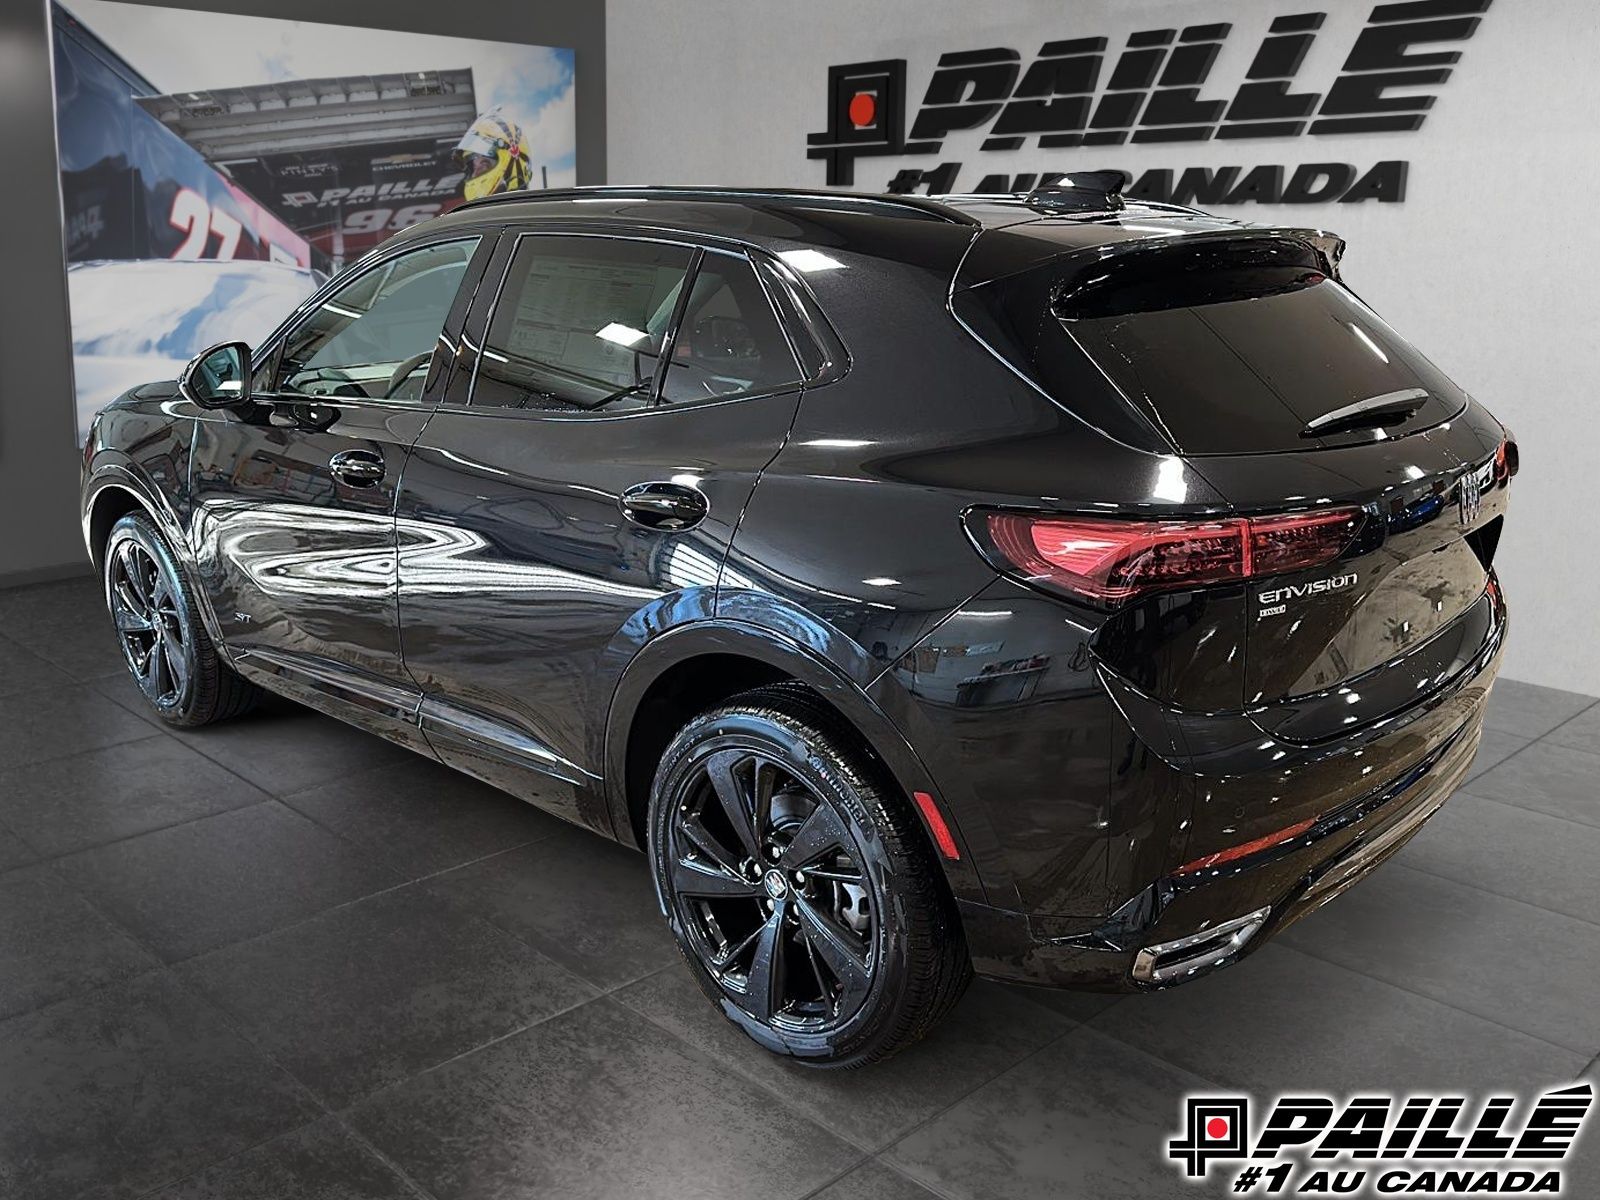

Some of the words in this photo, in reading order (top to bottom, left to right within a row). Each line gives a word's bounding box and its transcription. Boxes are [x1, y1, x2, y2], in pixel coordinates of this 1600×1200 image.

[1096, 161, 1409, 204] ANADA
[170, 188, 242, 260] 27
[343, 203, 442, 235] 96
